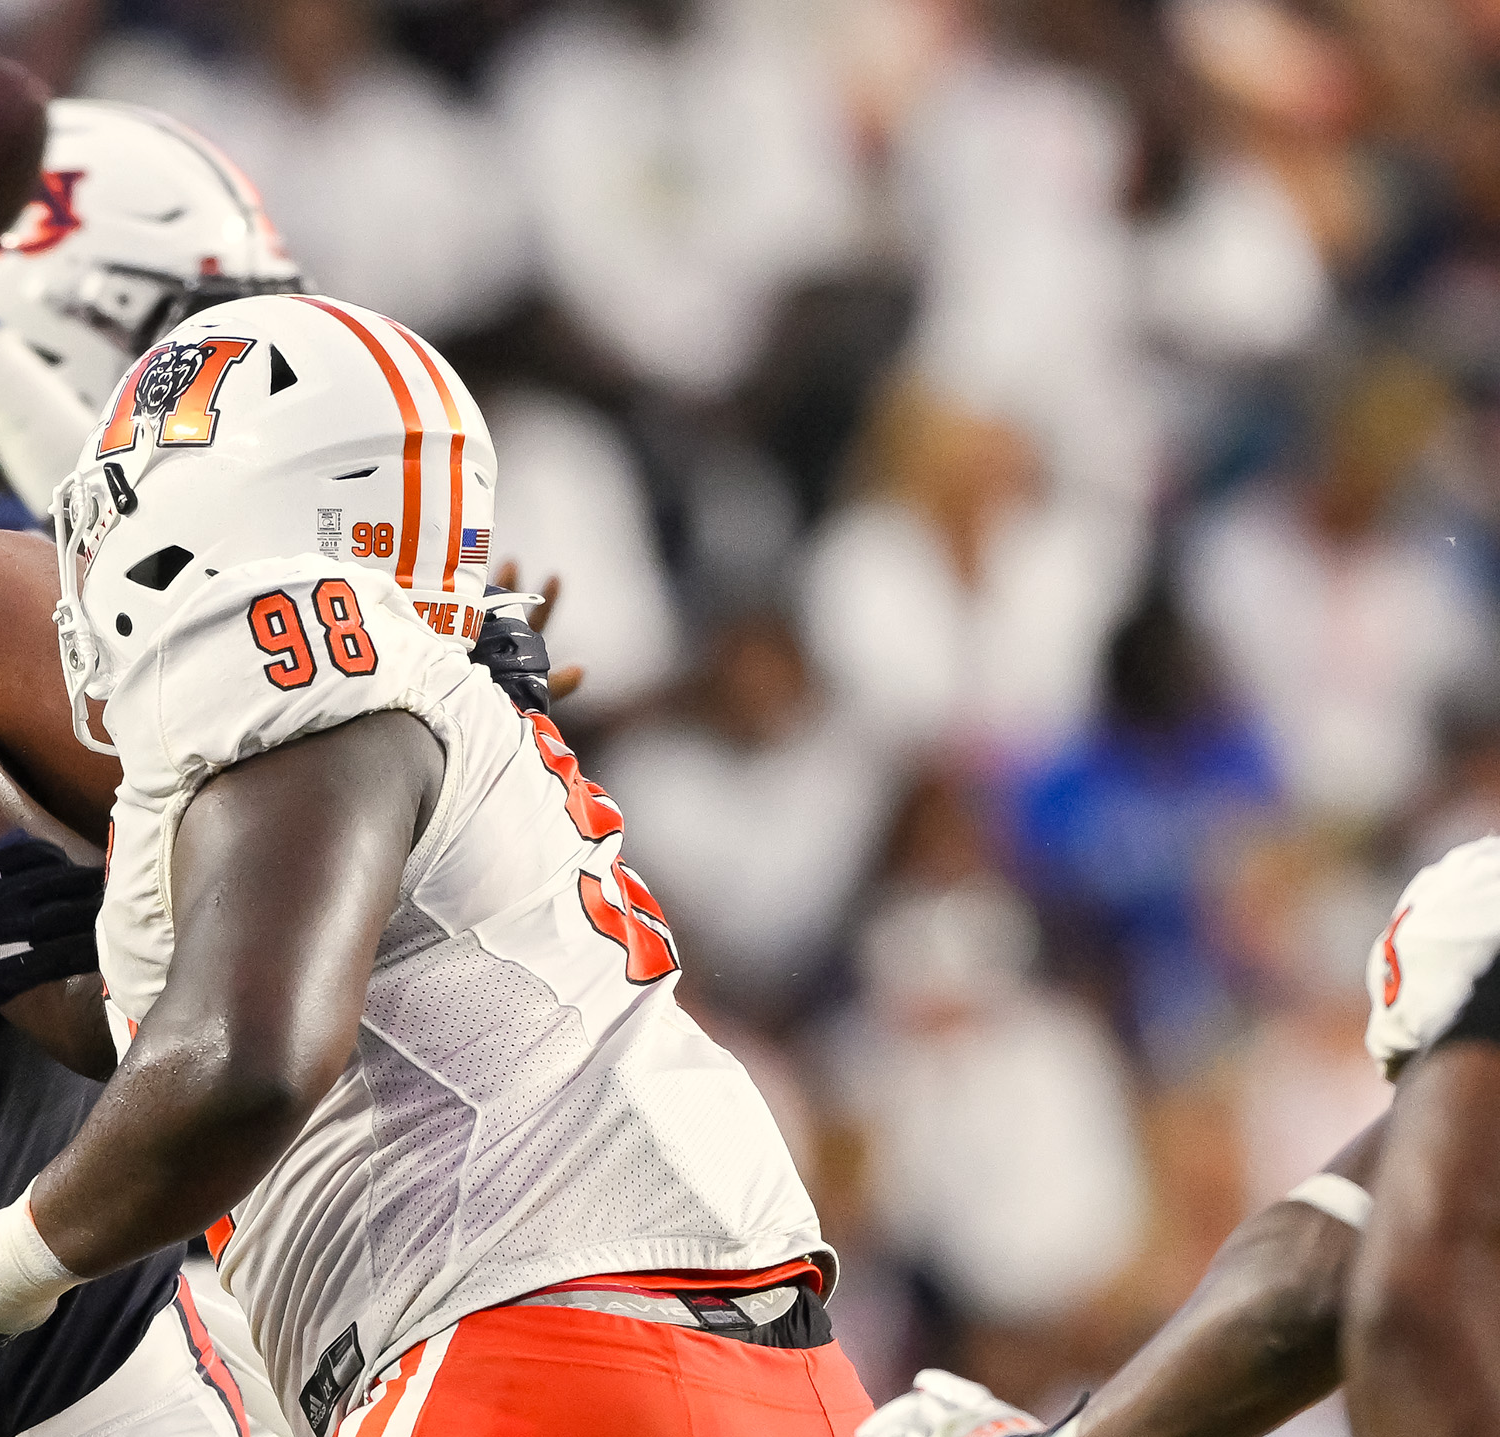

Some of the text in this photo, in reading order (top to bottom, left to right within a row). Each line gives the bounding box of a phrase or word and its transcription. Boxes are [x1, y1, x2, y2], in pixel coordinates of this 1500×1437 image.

[351, 522, 394, 558] 98
[247, 578, 379, 691] 98
[412, 601, 459, 636] THE
